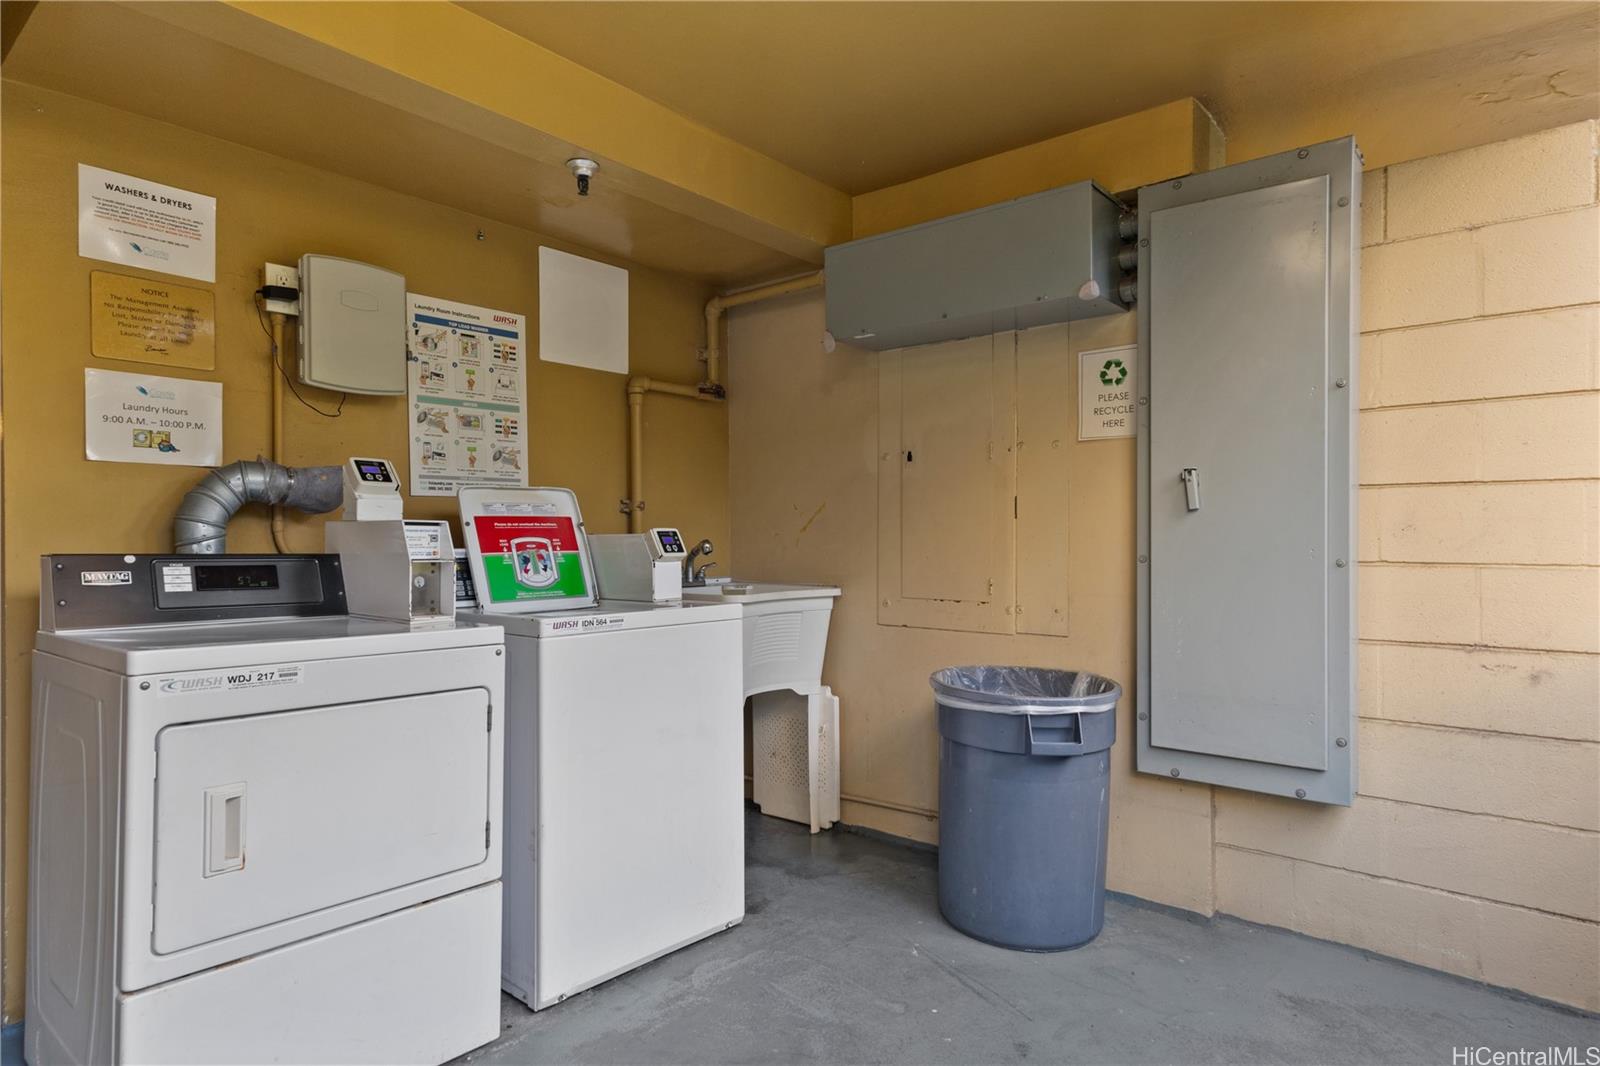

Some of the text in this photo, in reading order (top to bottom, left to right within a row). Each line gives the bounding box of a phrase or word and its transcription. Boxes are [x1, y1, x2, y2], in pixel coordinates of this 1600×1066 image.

[104, 182, 149, 200] WASHERS
[160, 196, 193, 211] DRYERS
[141, 288, 169, 298] NOTICE
[126, 297, 170, 309] Management
[414, 303, 480, 320] Laundry Room Instructions
[118, 321, 139, 329] Please
[493, 315, 518, 325] WASH
[1098, 391, 1129, 402] PLEASE
[122, 403, 189, 416] Laundry Hours
[1093, 404, 1135, 416] RECYCLE
[102, 414, 124, 424] 9:00
[126, 417, 149, 426] A.M.
[160, 420, 184, 429] 10:00
[186, 422, 207, 431] P.M.
[1102, 418, 1125, 428] HERE
[84, 572, 129, 581] MAYTAG
[552, 620, 579, 630] WASH
[581, 619, 595, 627] IDN
[595, 618, 607, 626] 564
[181, 676, 223, 689] WASH
[227, 674, 252, 684] WDJ
[257, 672, 275, 682] 217
